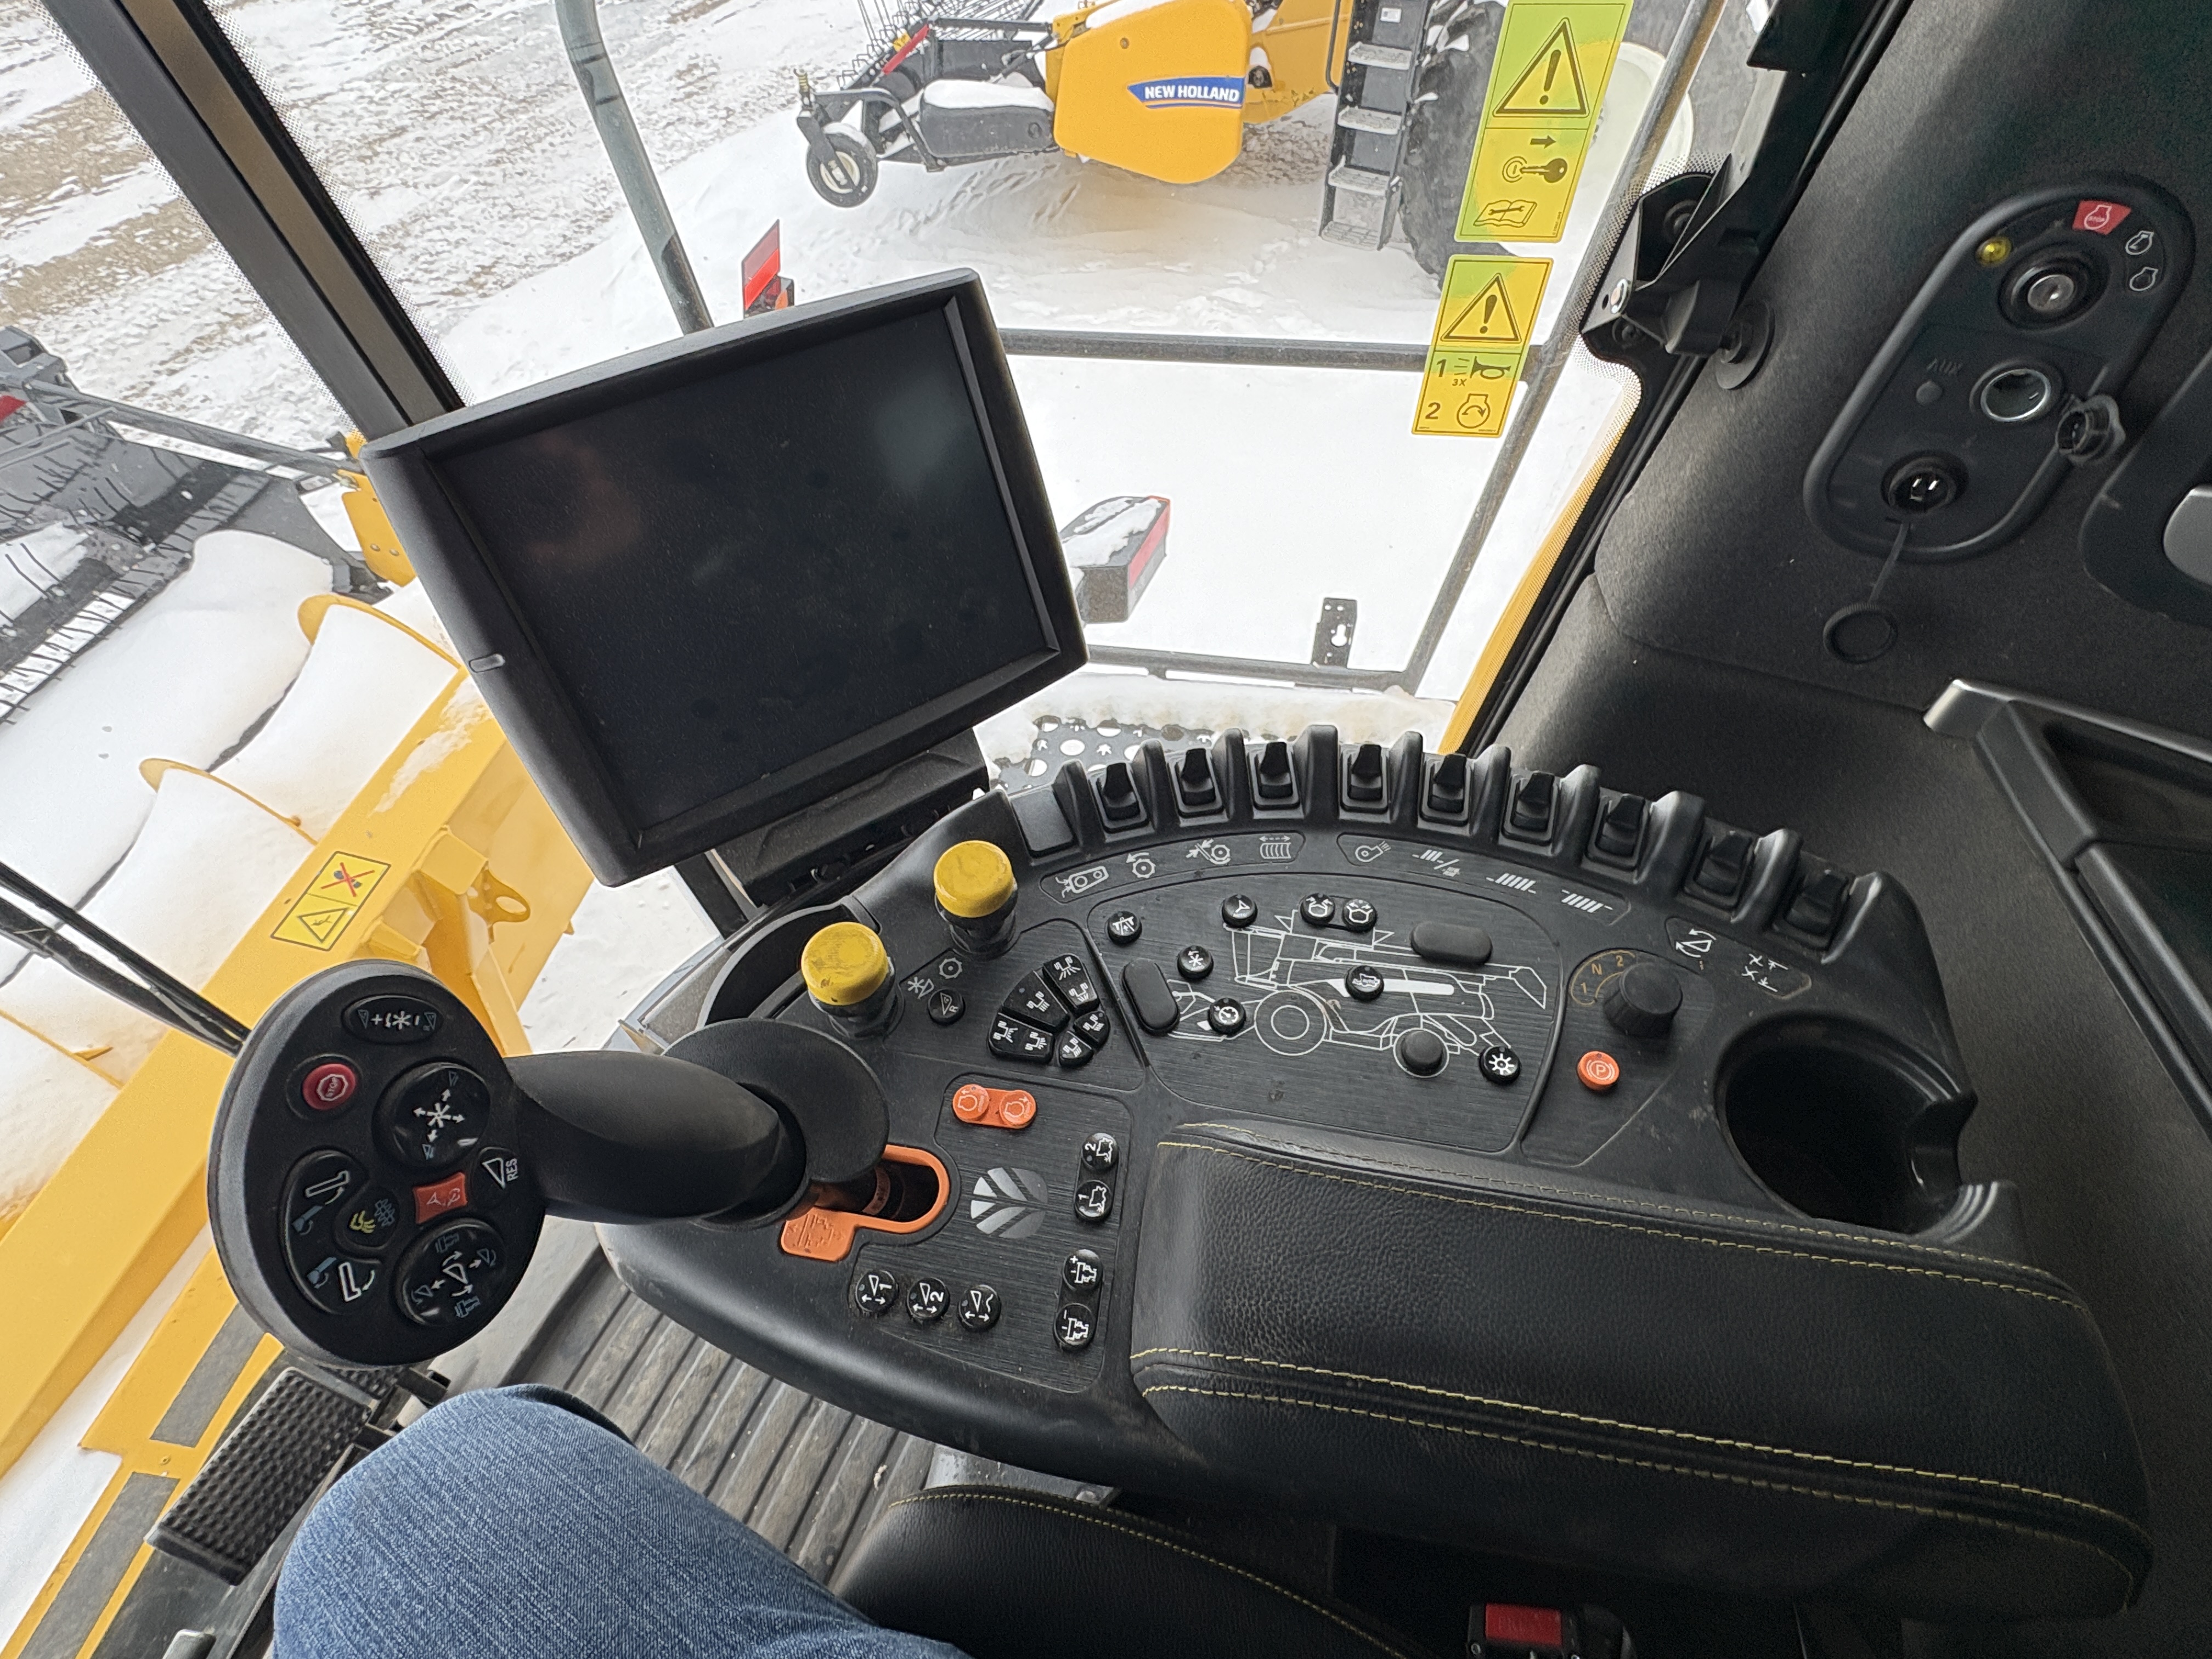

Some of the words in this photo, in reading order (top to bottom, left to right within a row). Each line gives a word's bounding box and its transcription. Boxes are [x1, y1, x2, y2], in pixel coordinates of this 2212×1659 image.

[1145, 85, 1175, 99] NEW
[1178, 85, 1240, 101] HOLLAND
[1436, 359, 1447, 377] 1
[1452, 379, 1468, 387] 3X
[1425, 402, 1441, 420] 2
[1581, 982, 1587, 995] 1
[1592, 963, 1602, 975] N
[1616, 955, 1624, 967] 2
[1596, 1064, 1606, 1075] P
[1085, 1143, 1096, 1152] 2
[505, 1158, 518, 1182] RES
[930, 1291, 944, 1302] 2
